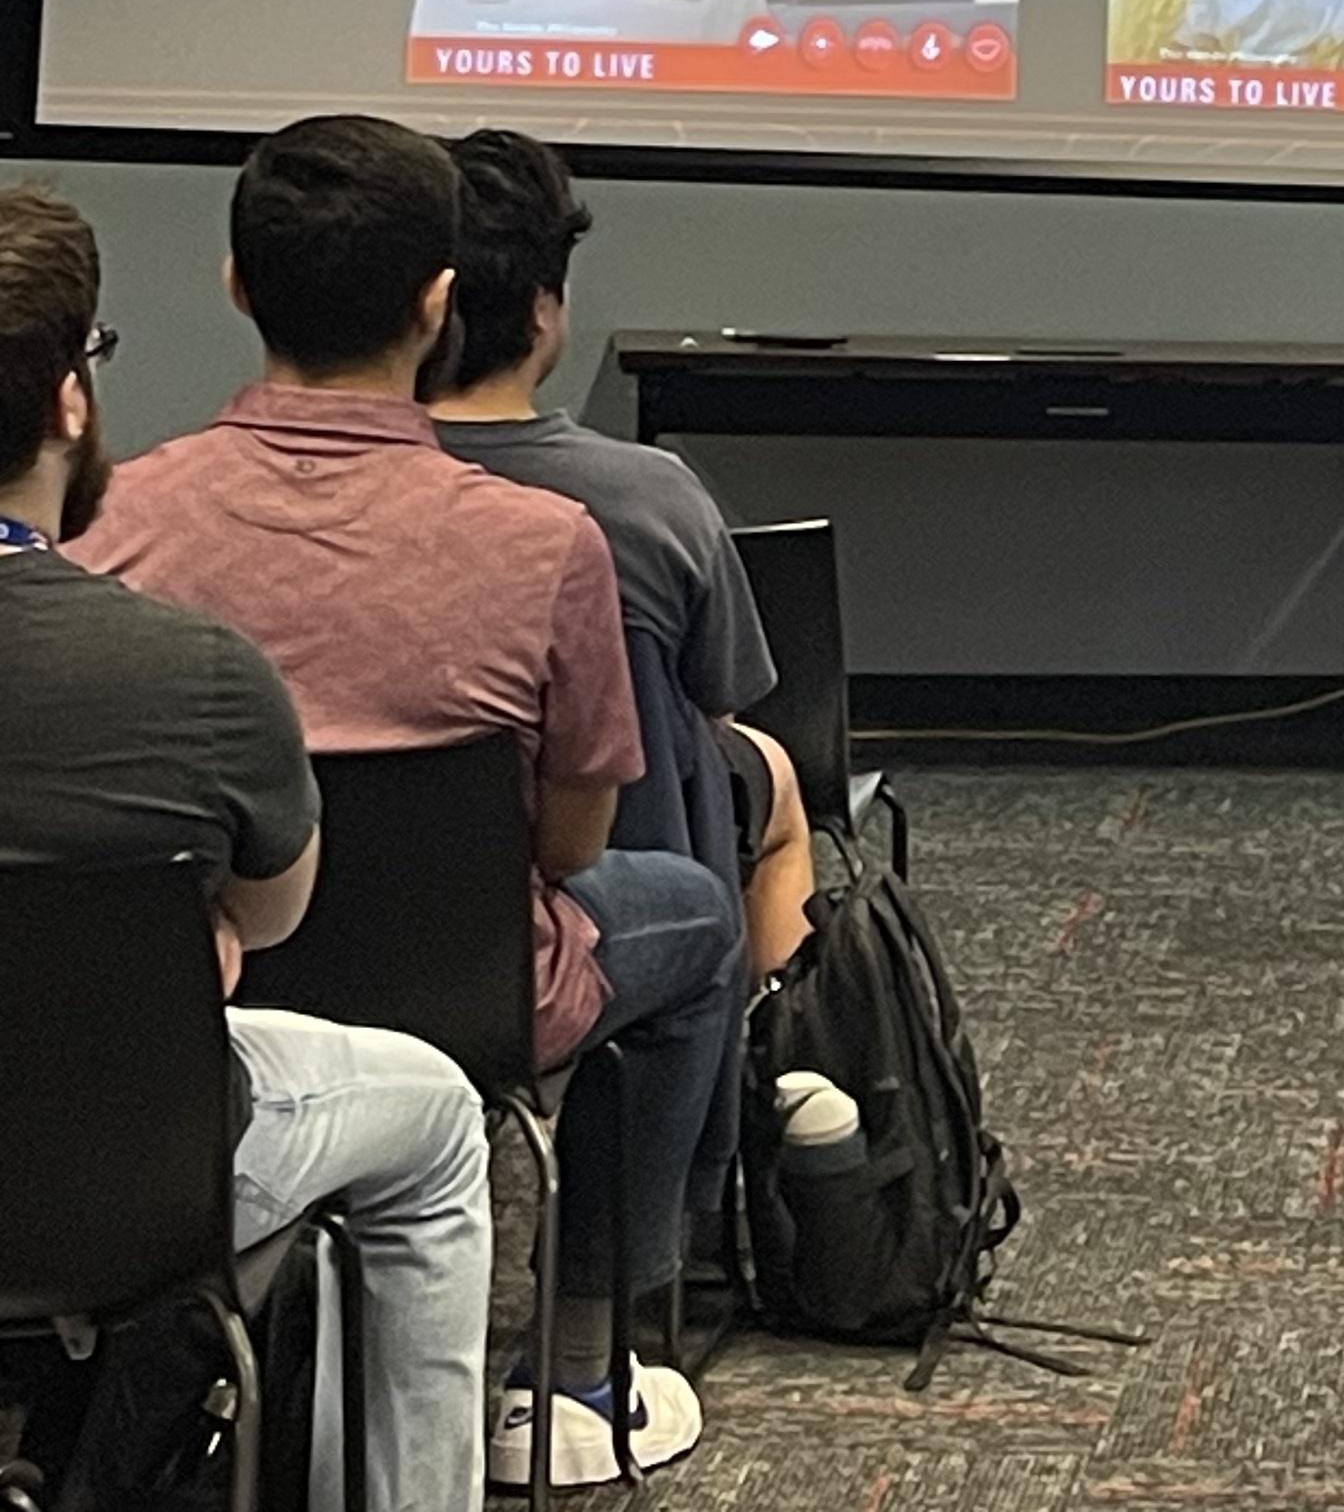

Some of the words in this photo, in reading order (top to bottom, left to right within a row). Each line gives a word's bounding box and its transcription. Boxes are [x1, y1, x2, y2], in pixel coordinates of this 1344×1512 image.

[436, 48, 532, 75] YOURS
[546, 51, 580, 77] TO
[594, 53, 654, 78] LIVE
[1120, 75, 1215, 103] YOURS
[1229, 79, 1263, 105] TO
[1276, 81, 1336, 107] LIVE
